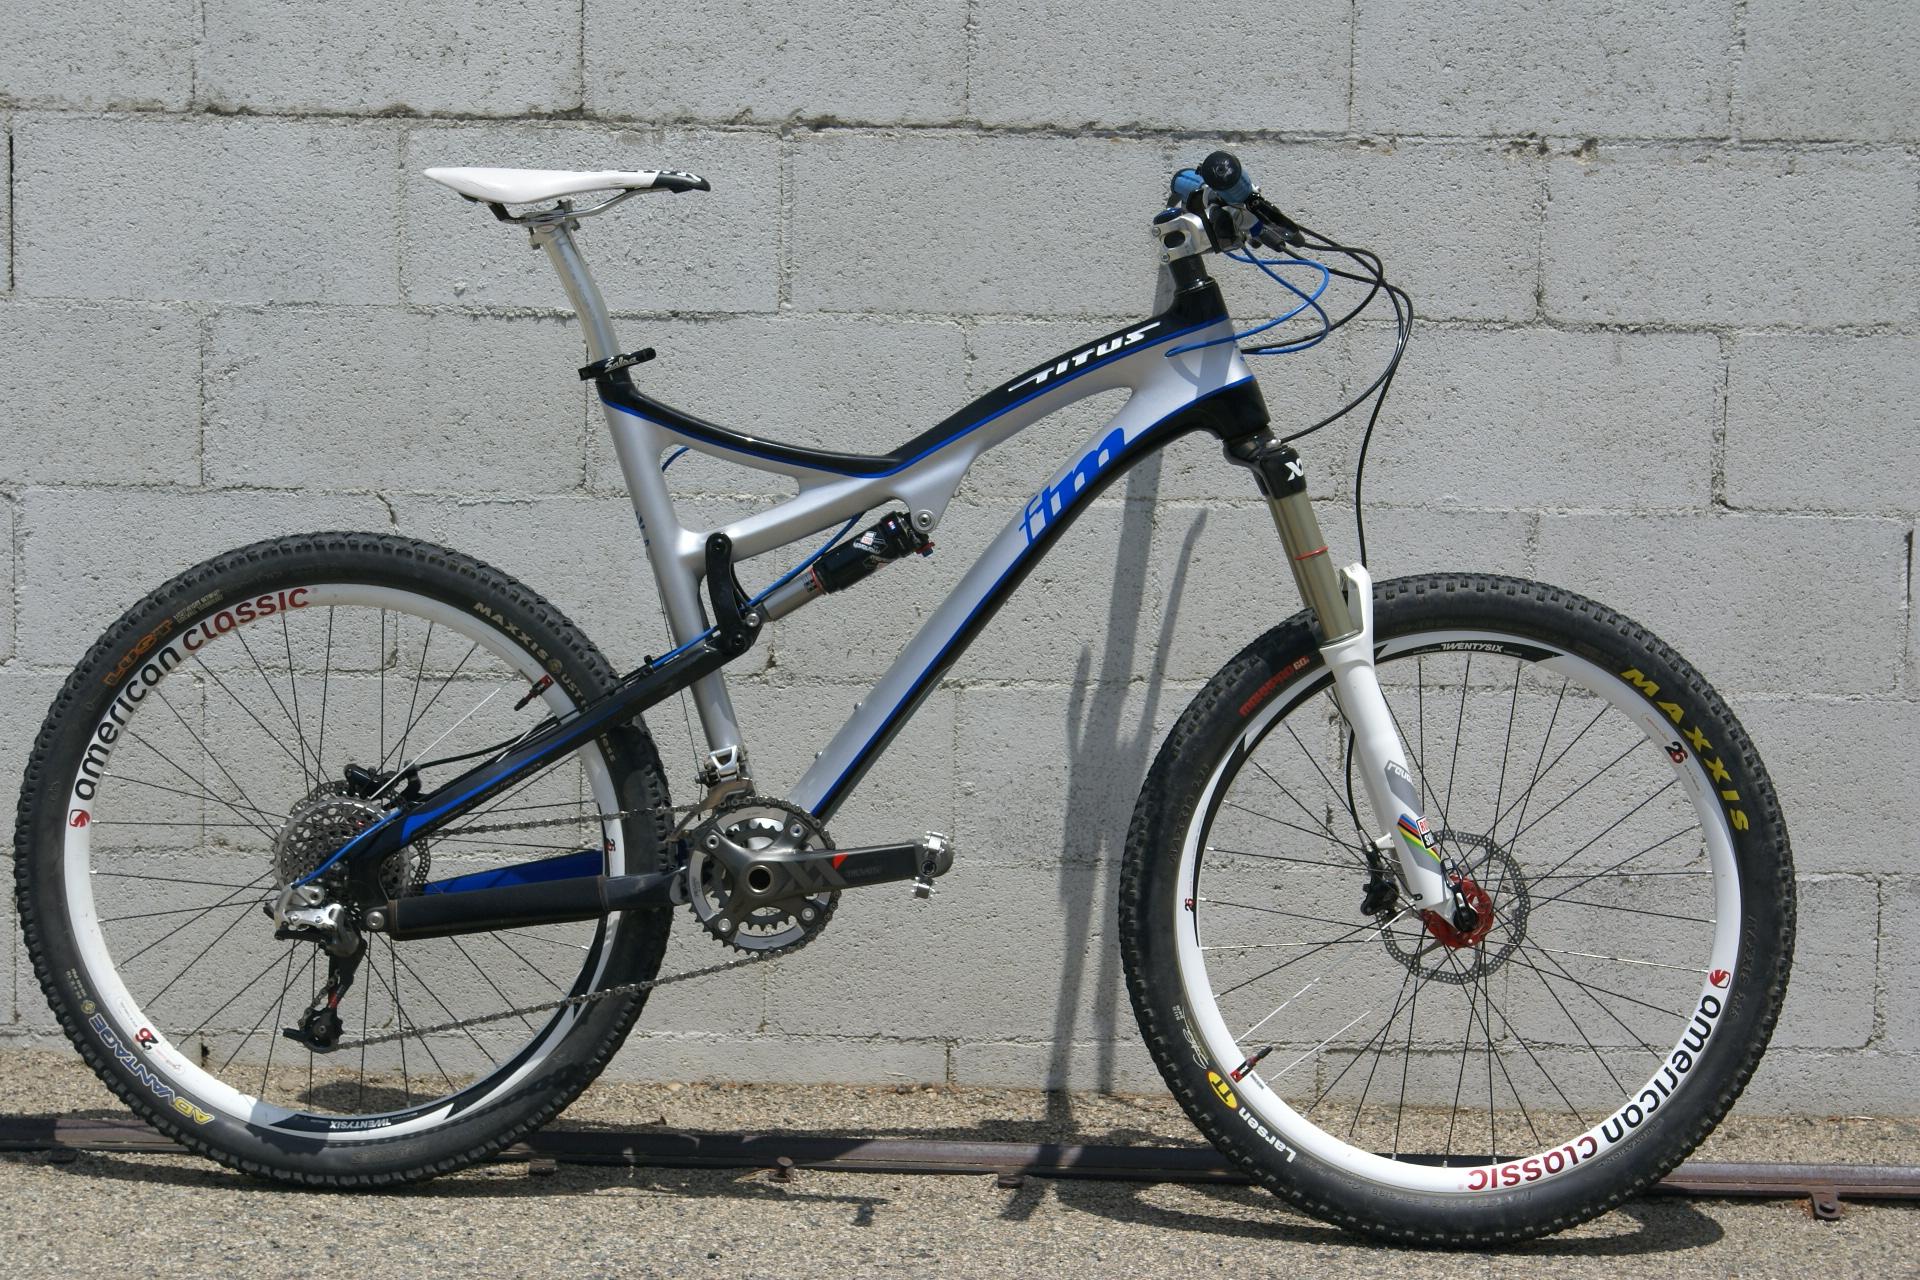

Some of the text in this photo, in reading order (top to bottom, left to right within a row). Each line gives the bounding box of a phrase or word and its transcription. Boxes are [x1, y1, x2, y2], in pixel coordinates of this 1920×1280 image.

[604, 356, 639, 374] Salsa
[1007, 321, 1161, 392] TITUS
[473, 602, 550, 661] MAXXIS
[560, 675, 584, 700] UST
[1440, 641, 1504, 654] TWENTYSIX
[74, 646, 183, 801] american
[1621, 668, 1749, 831] MAXXIS
[1664, 741, 1688, 764] 26
[89, 1012, 216, 1125] ADVANTAGE
[136, 1027, 159, 1050] 26
[1602, 995, 1722, 1144] american
[329, 1118, 392, 1130] TWENTYSIX
[1211, 1080, 1297, 1164] Larsen TT
